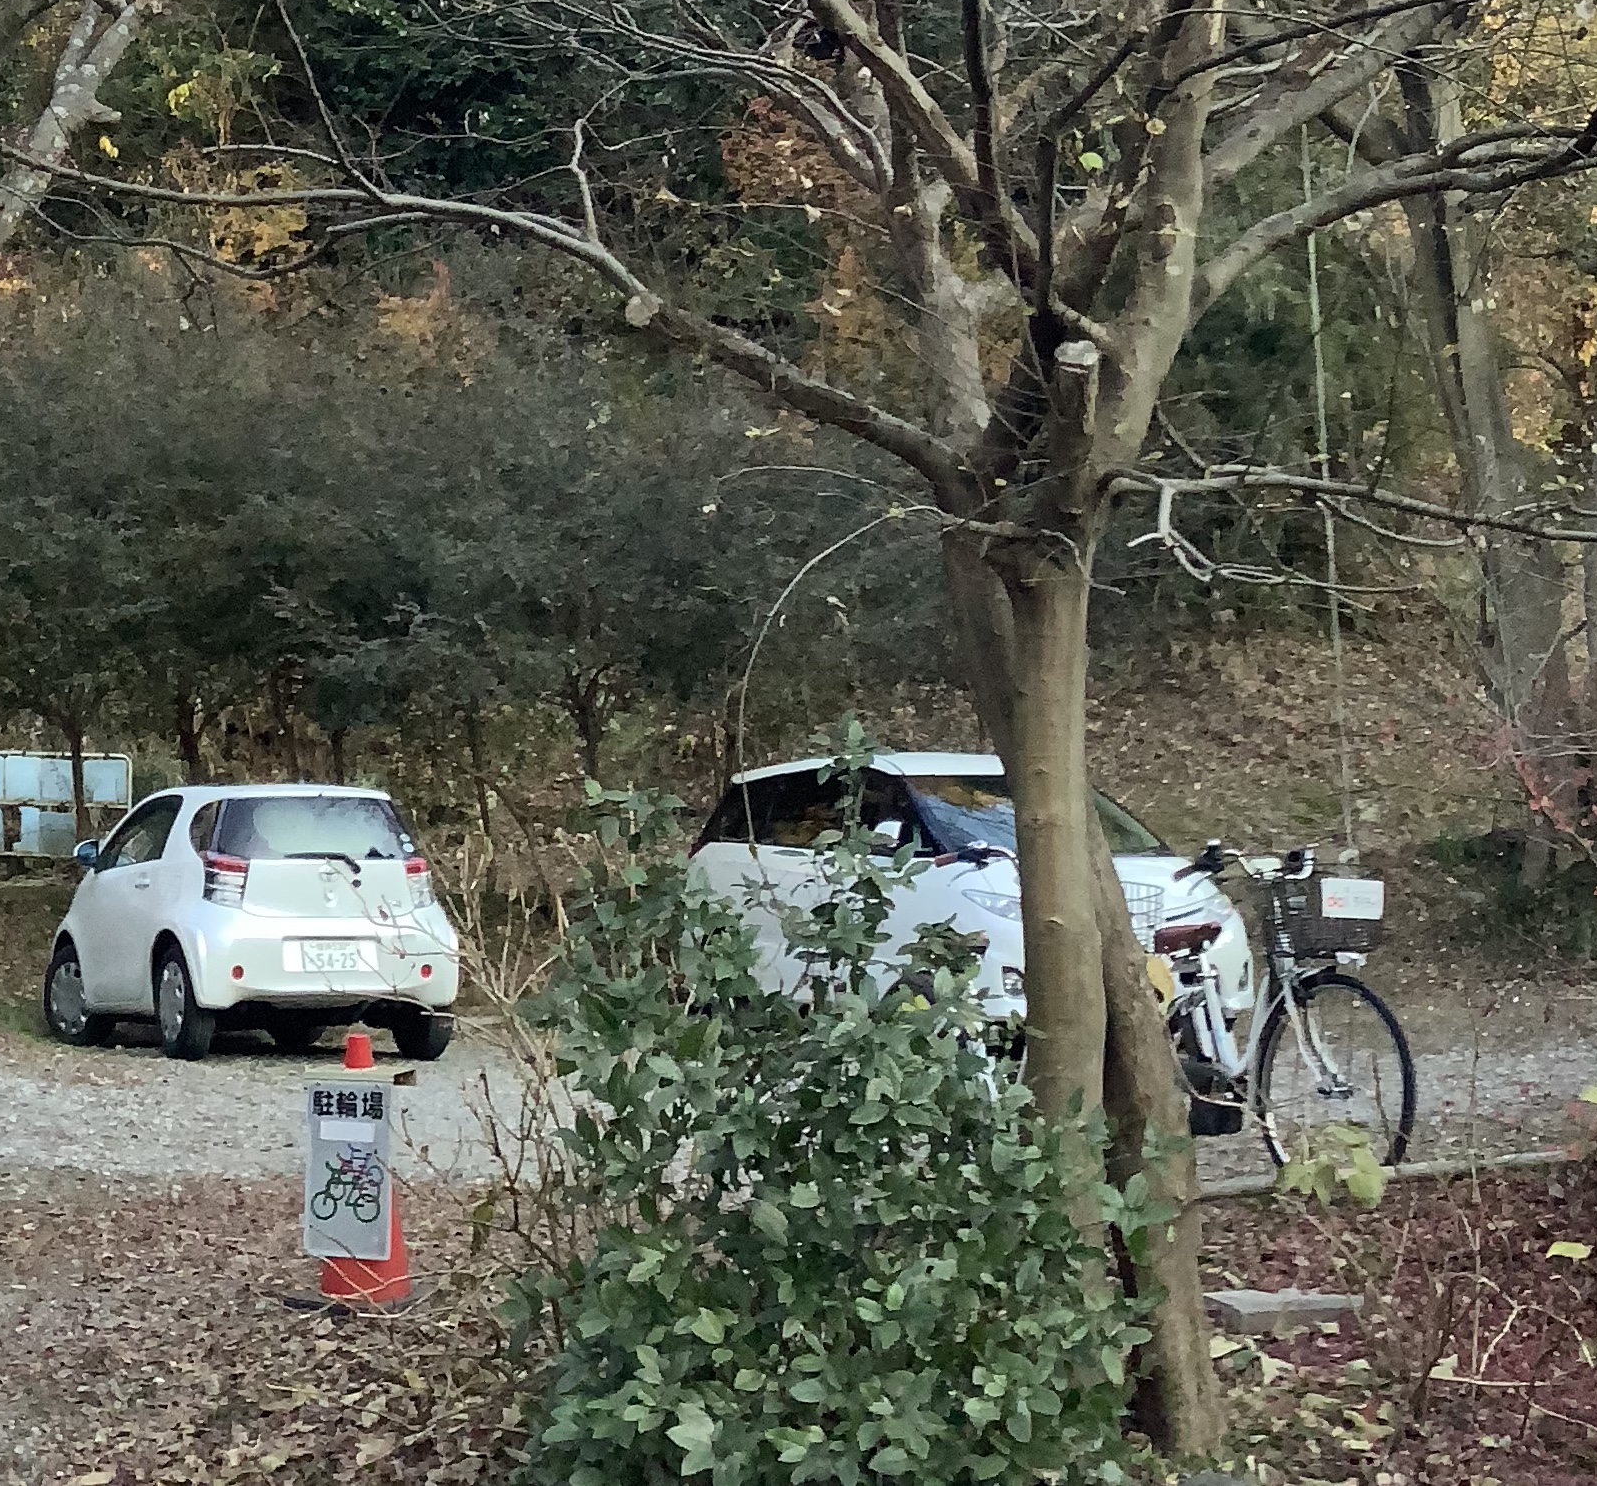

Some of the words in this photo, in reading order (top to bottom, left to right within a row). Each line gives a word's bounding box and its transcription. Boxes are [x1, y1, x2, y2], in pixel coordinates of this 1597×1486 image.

[315, 952, 357, 970] 54-25
[312, 1089, 384, 1120] 駐輪場
